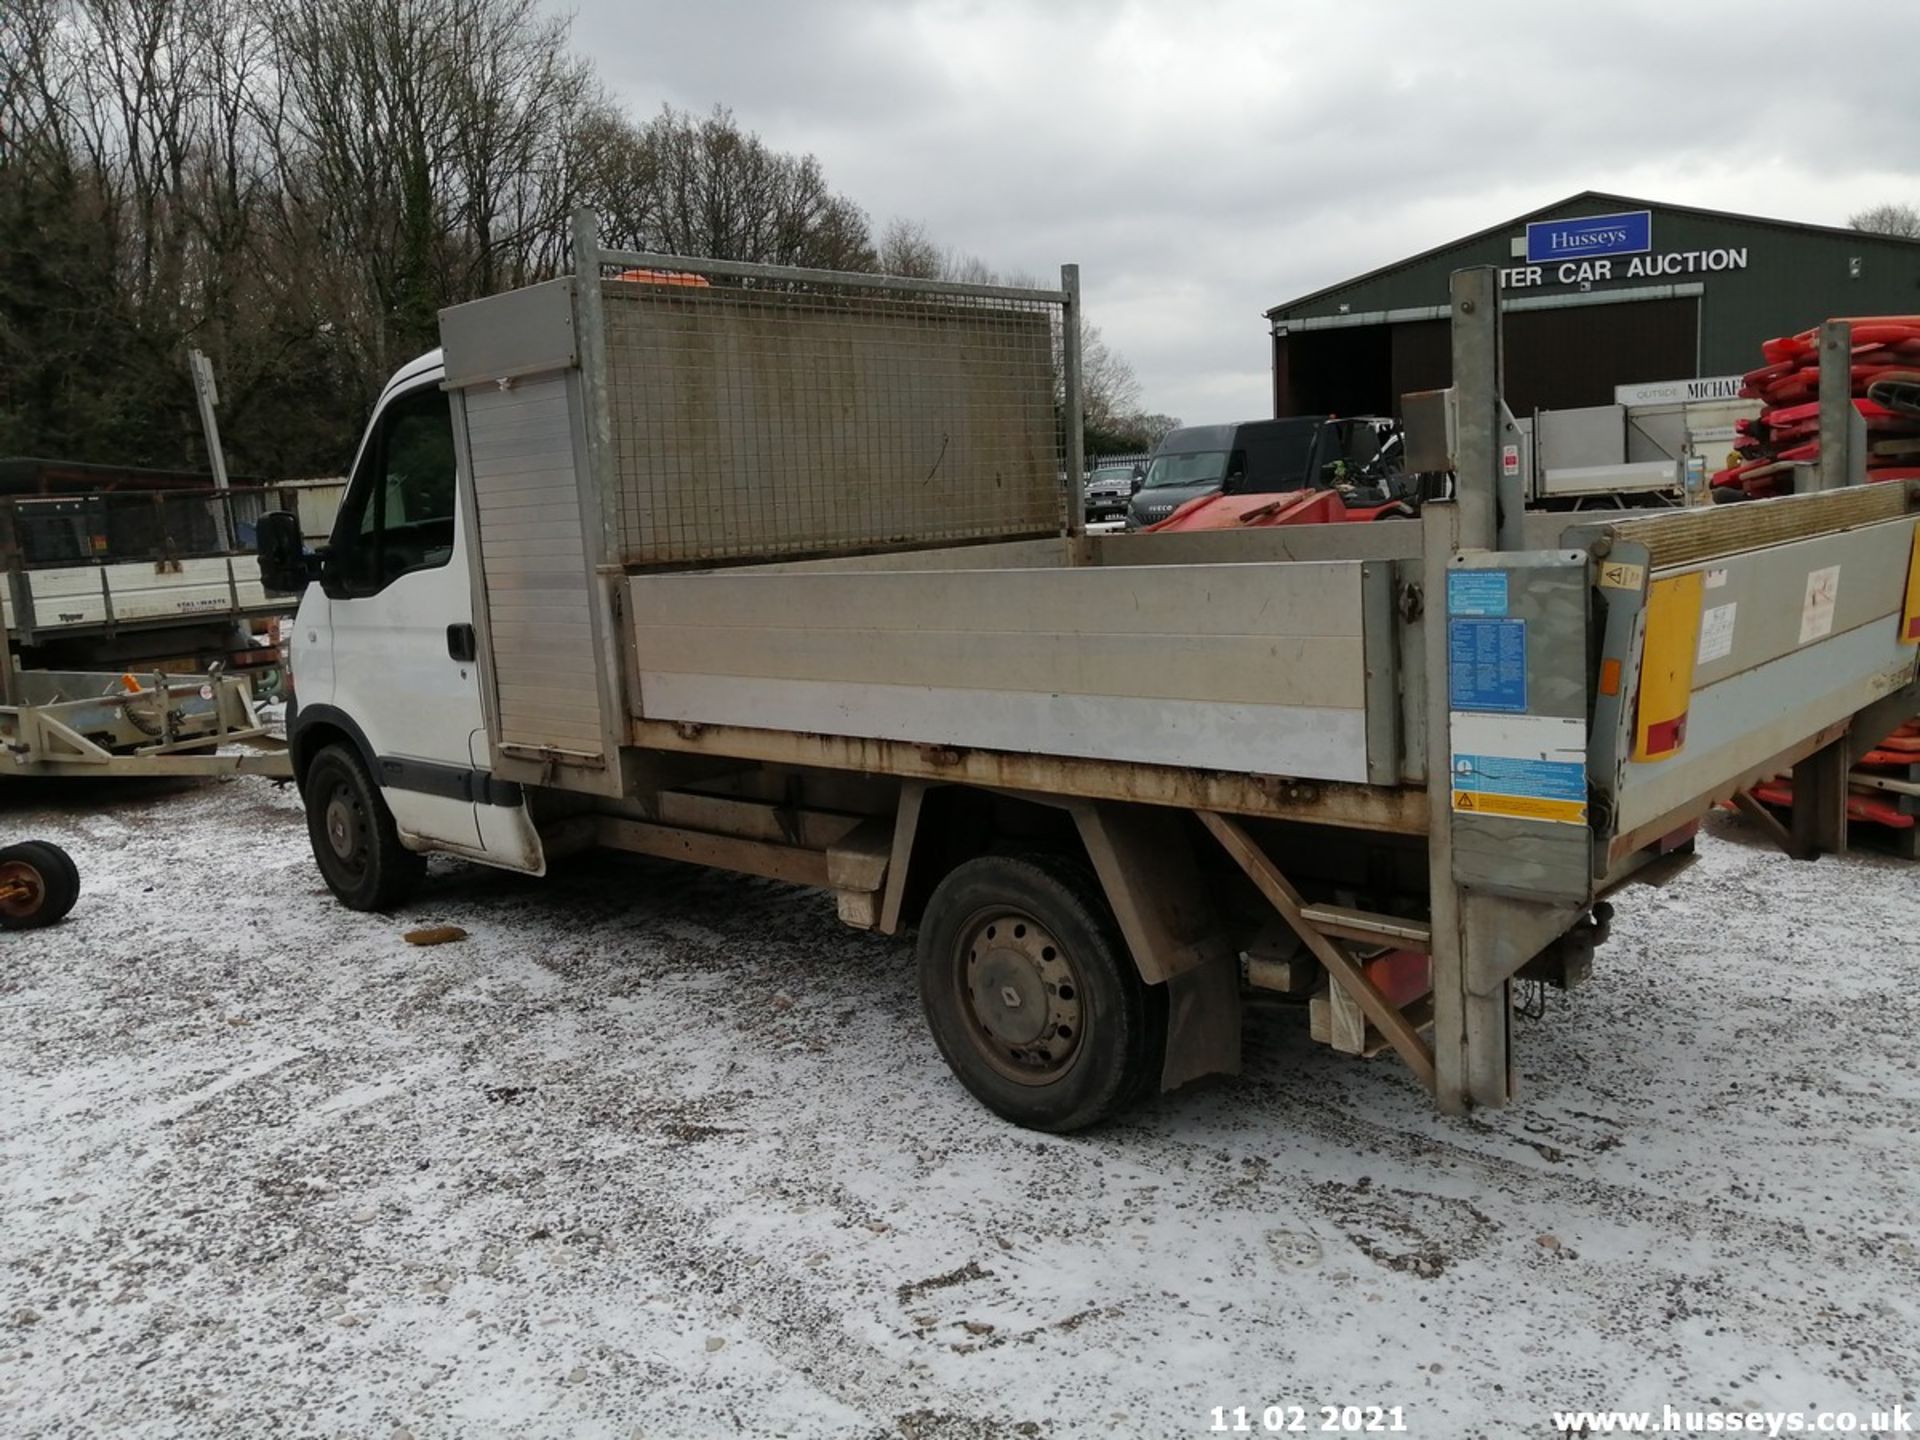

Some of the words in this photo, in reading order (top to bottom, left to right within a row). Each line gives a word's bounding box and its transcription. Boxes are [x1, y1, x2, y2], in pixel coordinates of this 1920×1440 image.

[1551, 228, 1627, 249] Husseys
[1500, 266, 1542, 289] TER
[1558, 260, 1611, 284] CAR
[1626, 248, 1748, 278] AUCTION
